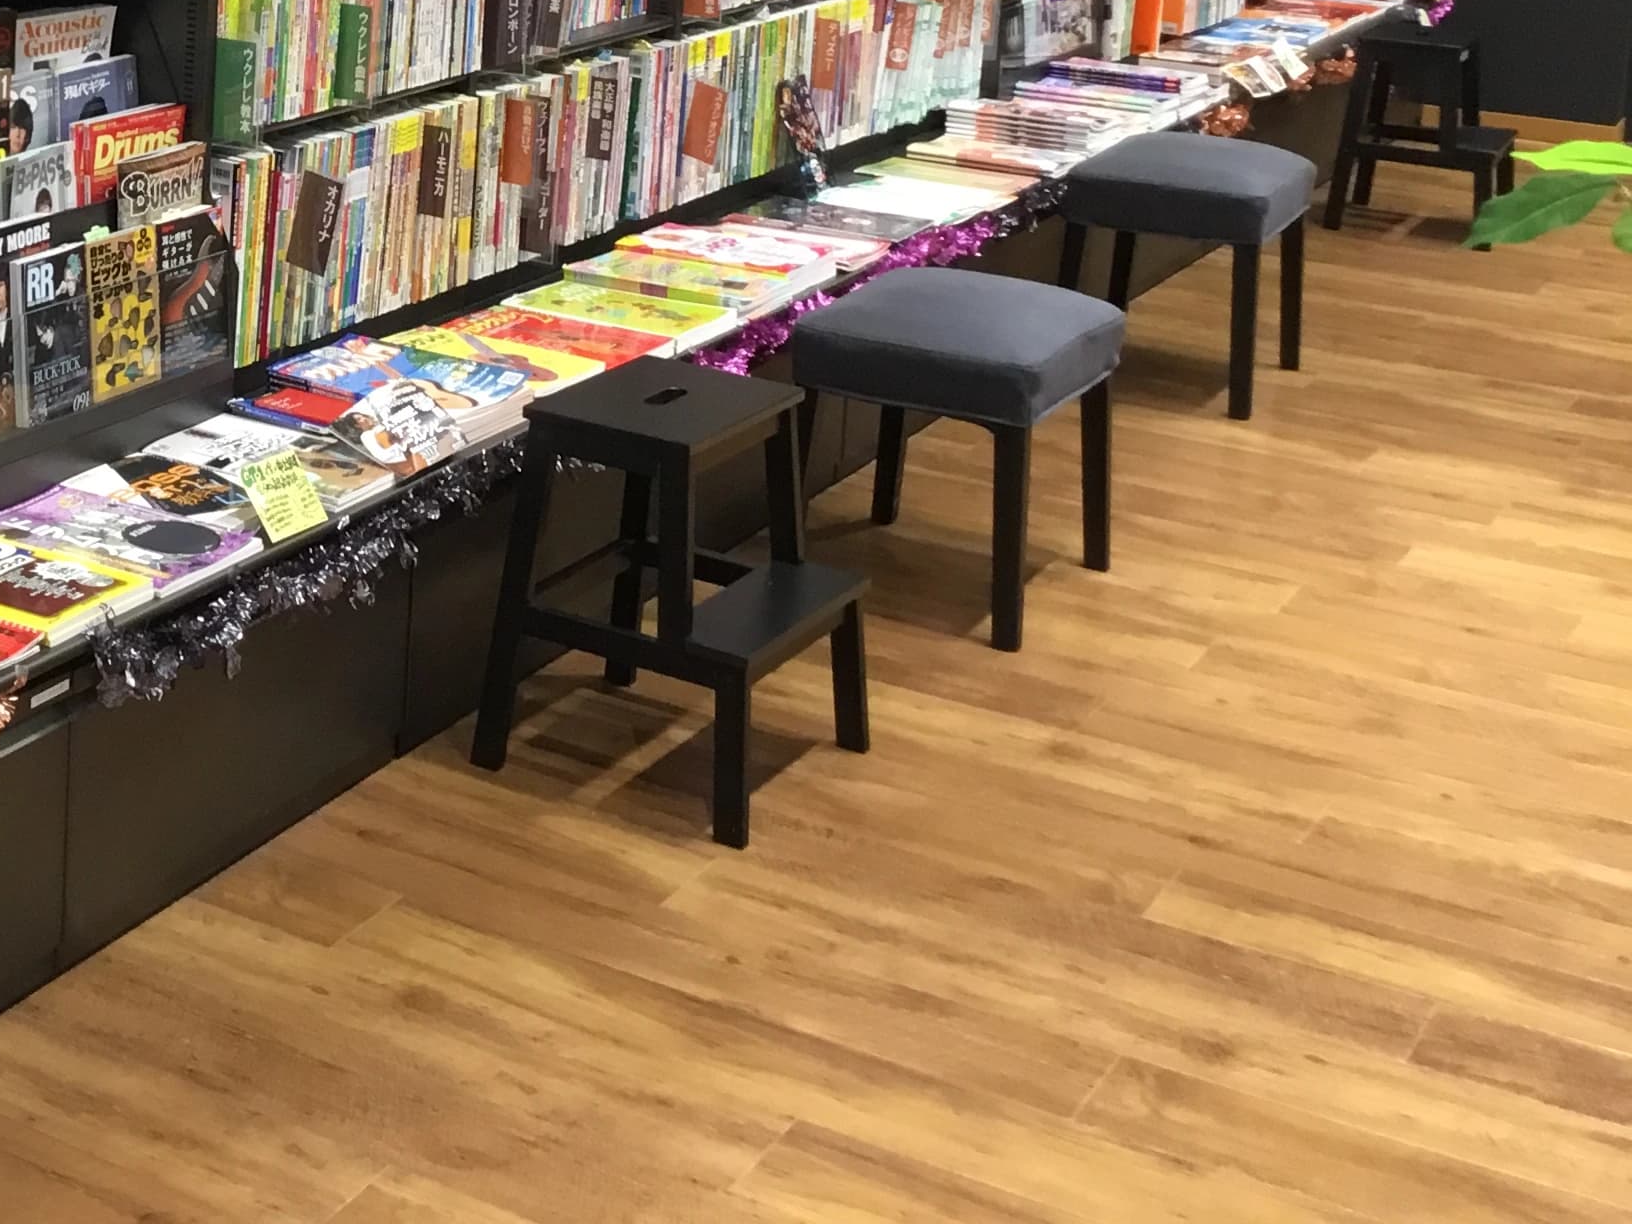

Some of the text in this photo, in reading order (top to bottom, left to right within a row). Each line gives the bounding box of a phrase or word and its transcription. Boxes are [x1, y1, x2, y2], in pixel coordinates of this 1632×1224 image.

[20, 11, 106, 40] Acoustic
[23, 33, 91, 57] Guitar
[823, 24, 839, 73] ディズニー
[64, 78, 111, 100] 現代ギター
[93, 127, 179, 170] Drums
[433, 131, 450, 197] ハーモニカ
[317, 185, 341, 243] オカリナ
[7, 222, 50, 254] MOORE
[161, 229, 193, 246] 耳と感性で
[162, 242, 193, 258] ギターが
[27, 263, 54, 303] RR
